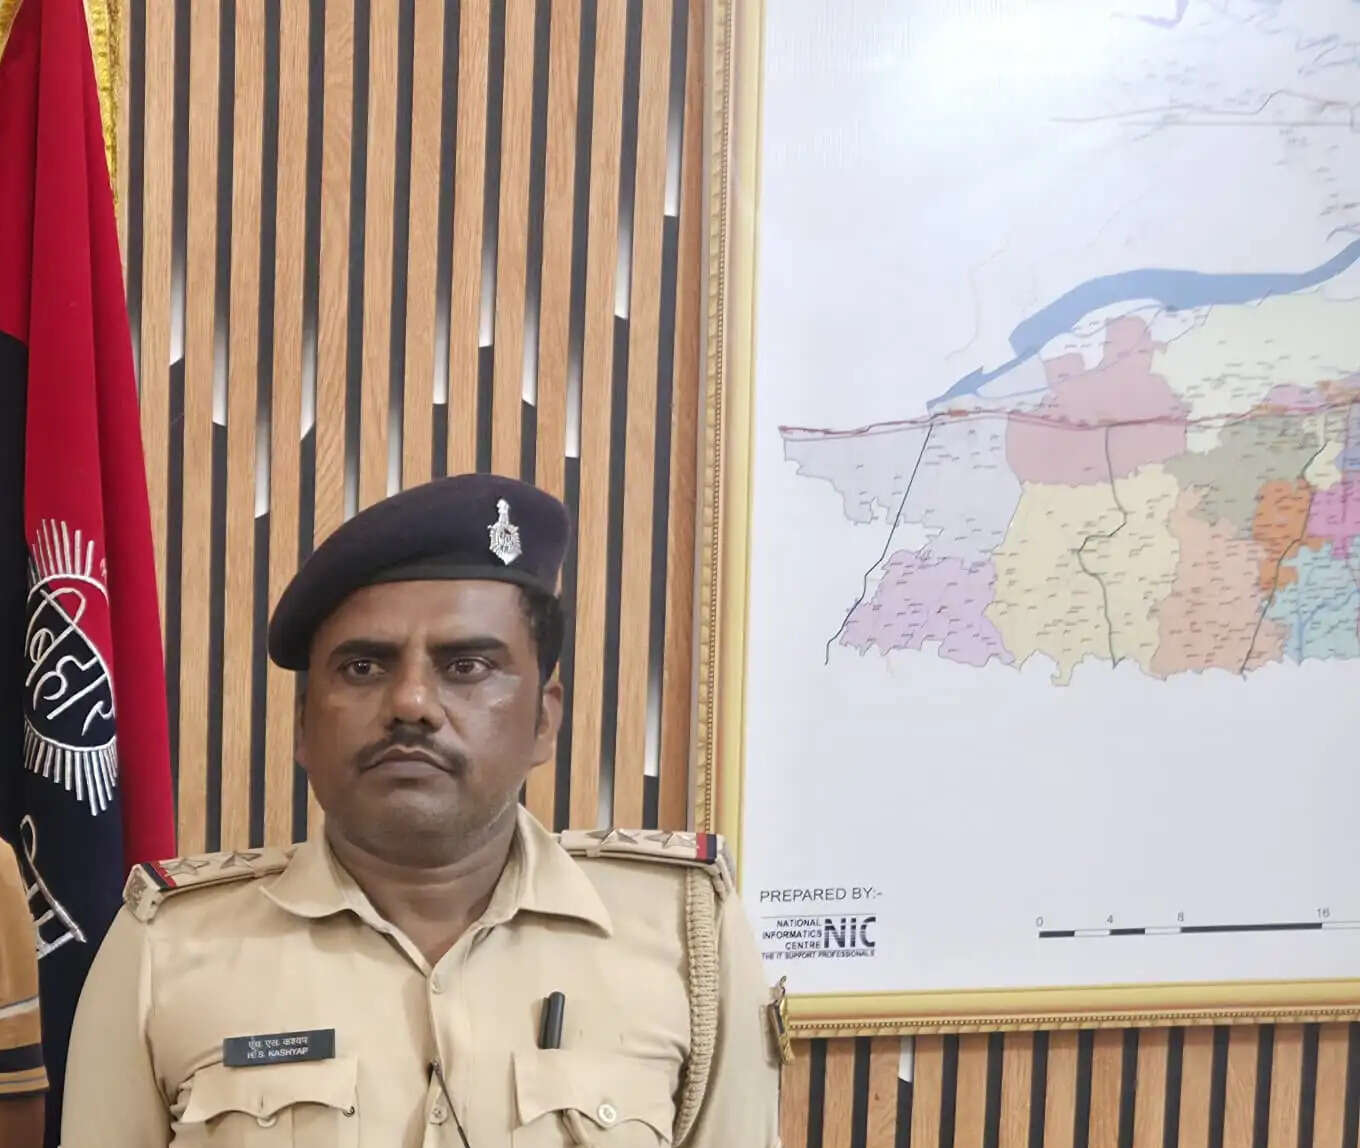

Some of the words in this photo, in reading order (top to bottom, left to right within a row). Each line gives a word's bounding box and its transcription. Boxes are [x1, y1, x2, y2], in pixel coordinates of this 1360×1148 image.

[760, 888, 847, 903] PREPARED
[776, 919, 822, 928] NATIONAL
[1036, 916, 1044, 928] 0
[1106, 913, 1114, 925] 4
[762, 929, 822, 940] INFORMATICS
[823, 916, 877, 948] NIC
[785, 941, 821, 950] CENTRE
[761, 951, 775, 960] THE
[785, 950, 816, 960] SUPPORT
[818, 949, 876, 959] PROFESSIONALS
[268, 1047, 309, 1057] KASHYAP
